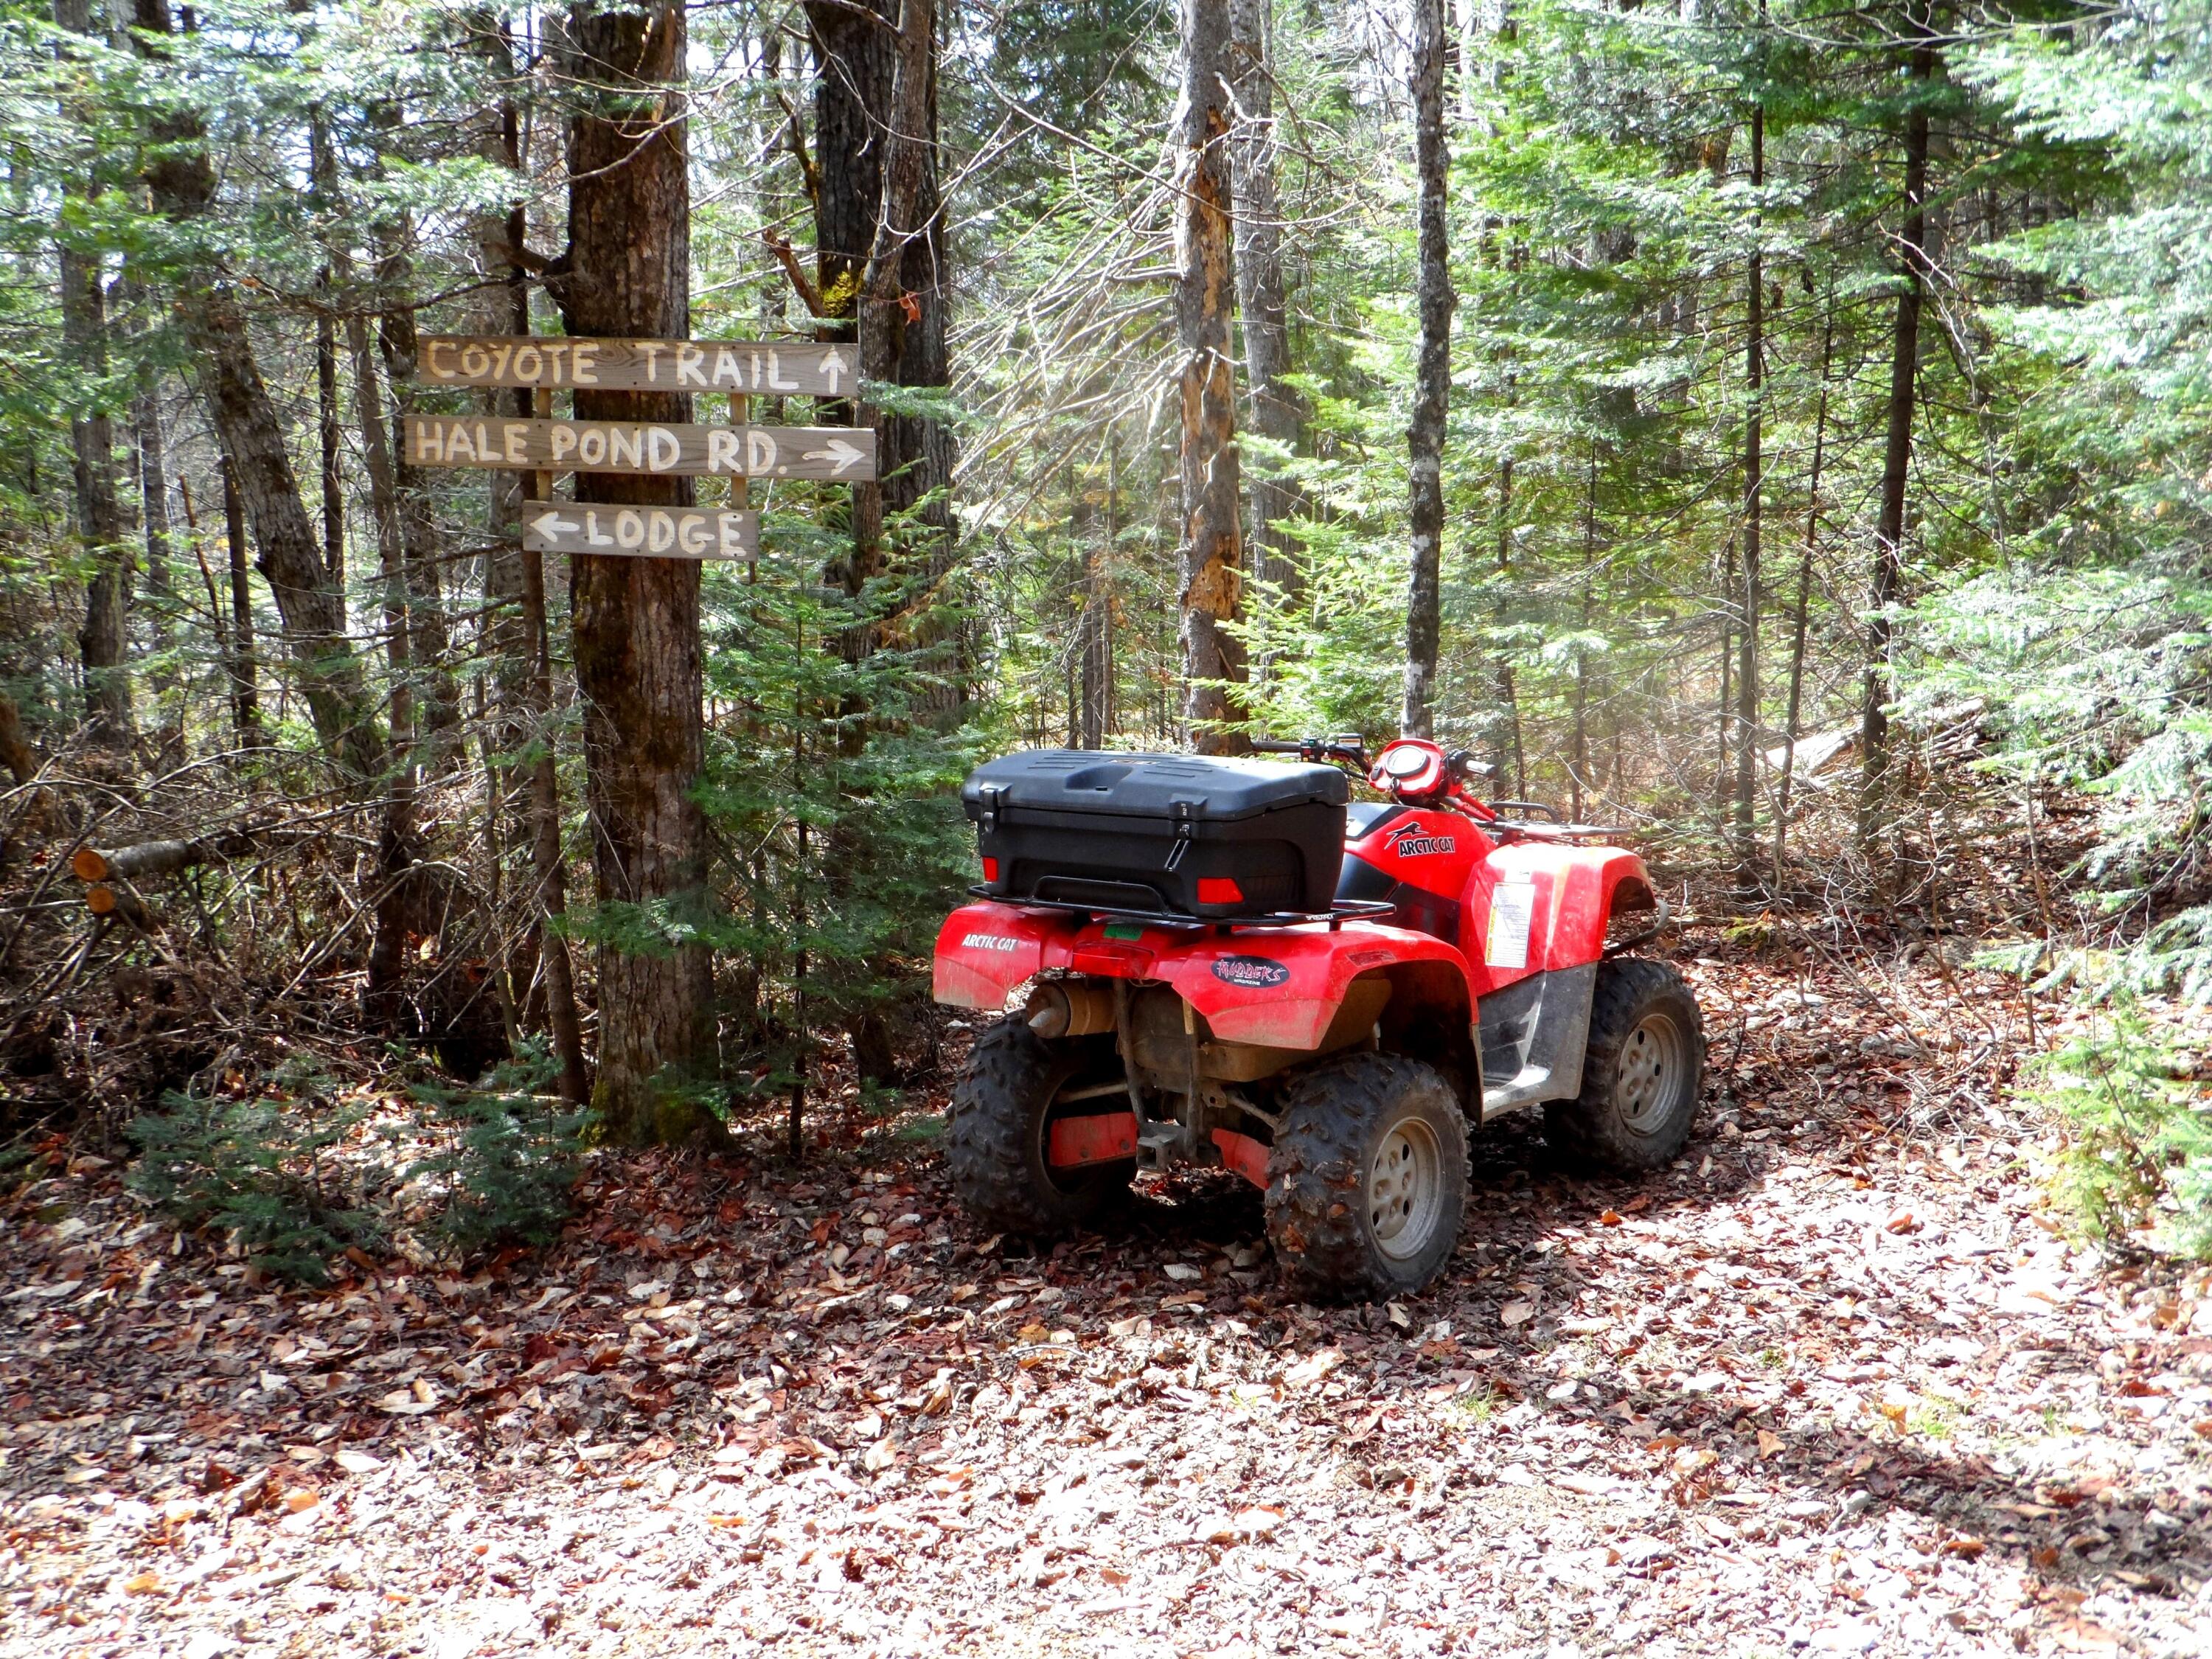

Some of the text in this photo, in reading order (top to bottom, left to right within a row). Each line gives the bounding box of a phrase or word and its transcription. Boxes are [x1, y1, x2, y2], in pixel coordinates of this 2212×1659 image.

[428, 341, 799, 389] COYOTE TRAIL
[417, 421, 787, 476] HALE POND RD.
[587, 510, 747, 557] LODGE
[1399, 837, 1455, 857] ARCTIC CAT
[961, 933, 1018, 951] ARCTIC CAT
